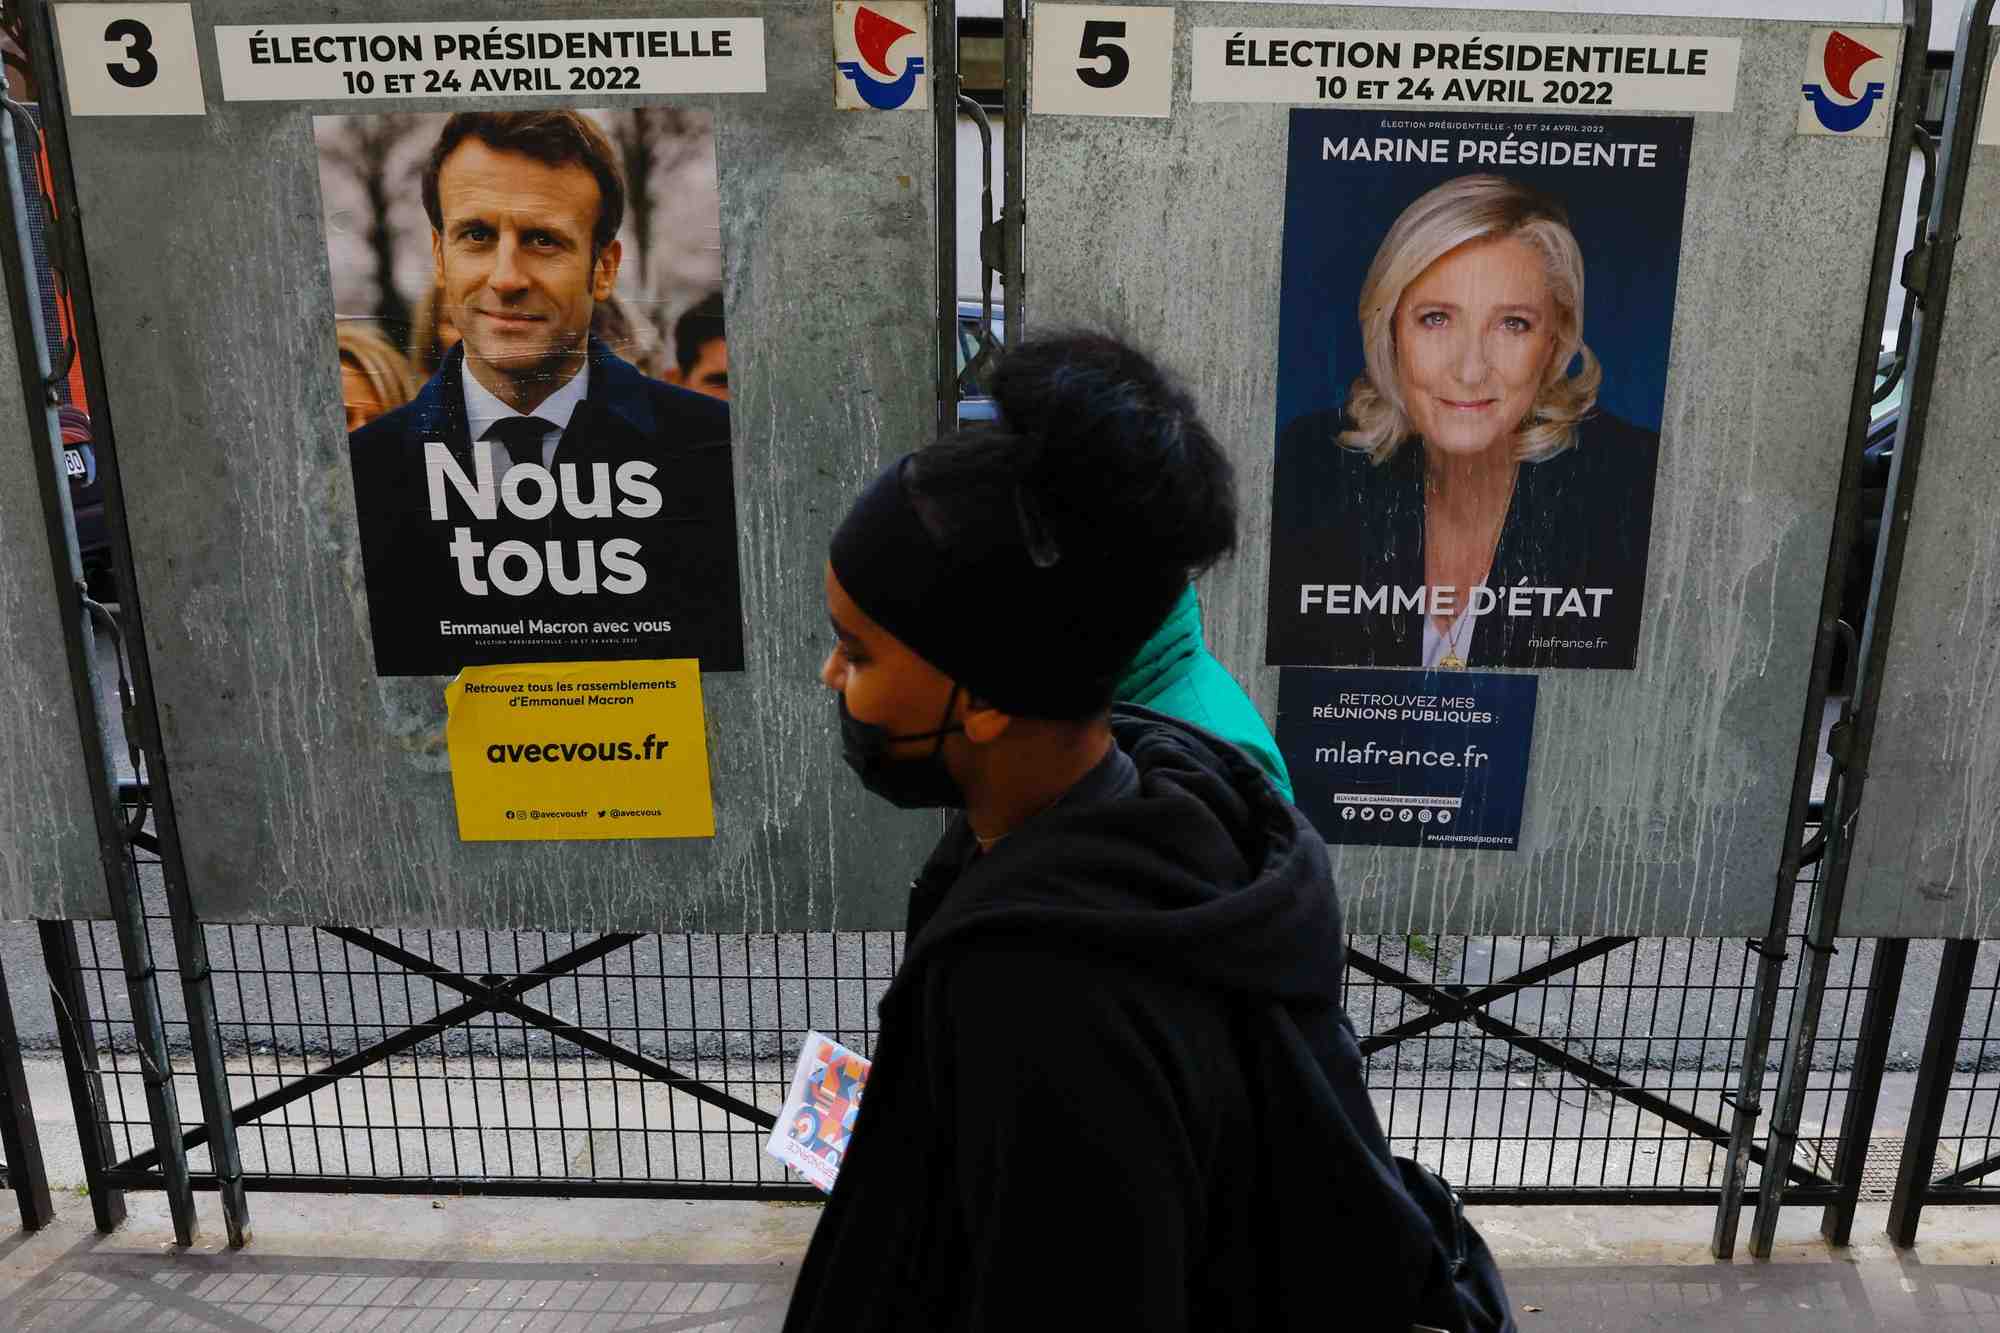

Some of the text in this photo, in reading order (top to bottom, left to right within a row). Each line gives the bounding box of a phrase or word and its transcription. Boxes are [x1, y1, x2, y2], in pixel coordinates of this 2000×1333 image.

[105, 19, 158, 87] 3
[249, 27, 733, 65] ÉLECTION PRÉSIDENTIELLE
[1077, 21, 1130, 89] 5
[1225, 31, 1708, 76] ÉLECTION PRÉSIDENTIELLE
[343, 66, 641, 95] 10 ET 24 AVRIL 2022
[1317, 76, 1613, 105] 10 ET 24 AVRIL 2022
[1322, 132, 1657, 169] MARINE PRÉSIDENTE
[423, 441, 663, 521] Nous
[449, 527, 647, 596] tous
[1300, 576, 1613, 618] FEMME D'ÉTAT
[440, 620, 672, 636] Emmanuel Macron avec vous
[1528, 635, 1608, 649] mlafrance.fr
[464, 680, 677, 694] Retrouvez tous les rassemblements
[509, 695, 634, 707] d'Emmanuel Macron
[1339, 693, 1475, 709] RETROUVEZ MES
[1312, 705, 1398, 720] RÉUNIONS
[1402, 710, 1492, 725] PUBLIQUES
[487, 733, 669, 764] avecvous.fr
[1315, 741, 1489, 769] mlafrance.fr
[530, 808, 662, 820] @avecvousfr @avecvous
